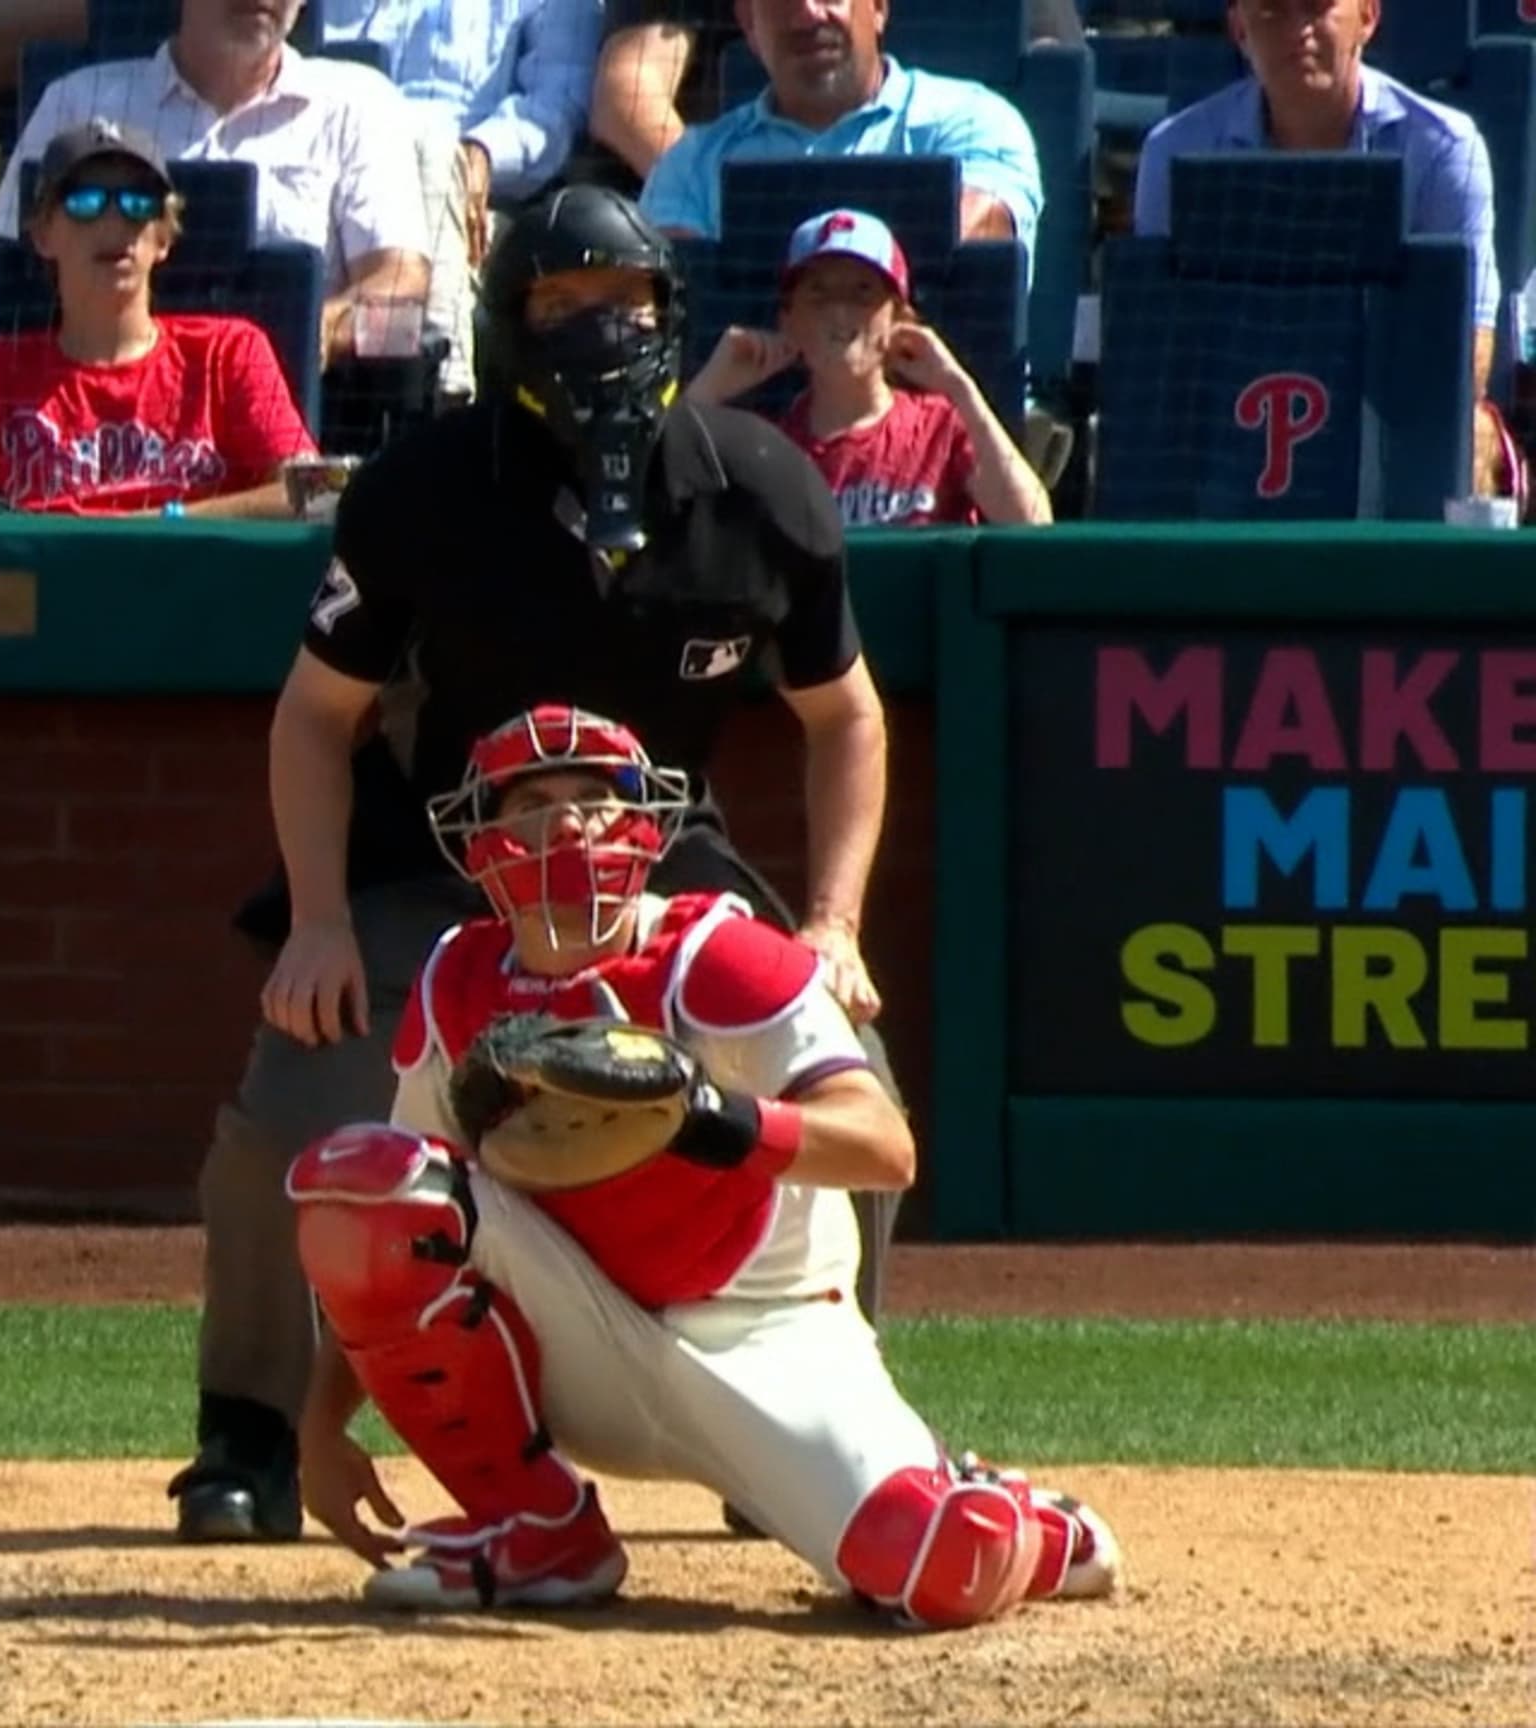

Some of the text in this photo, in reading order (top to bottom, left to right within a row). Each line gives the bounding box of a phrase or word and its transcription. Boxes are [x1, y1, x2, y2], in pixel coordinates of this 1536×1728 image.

[1, 409, 226, 503] Phillies
[1234, 372, 1330, 498] P
[1095, 645, 1536, 771] MAKE
[1223, 786, 1527, 911] MAI
[1120, 922, 1529, 1050] STRE
